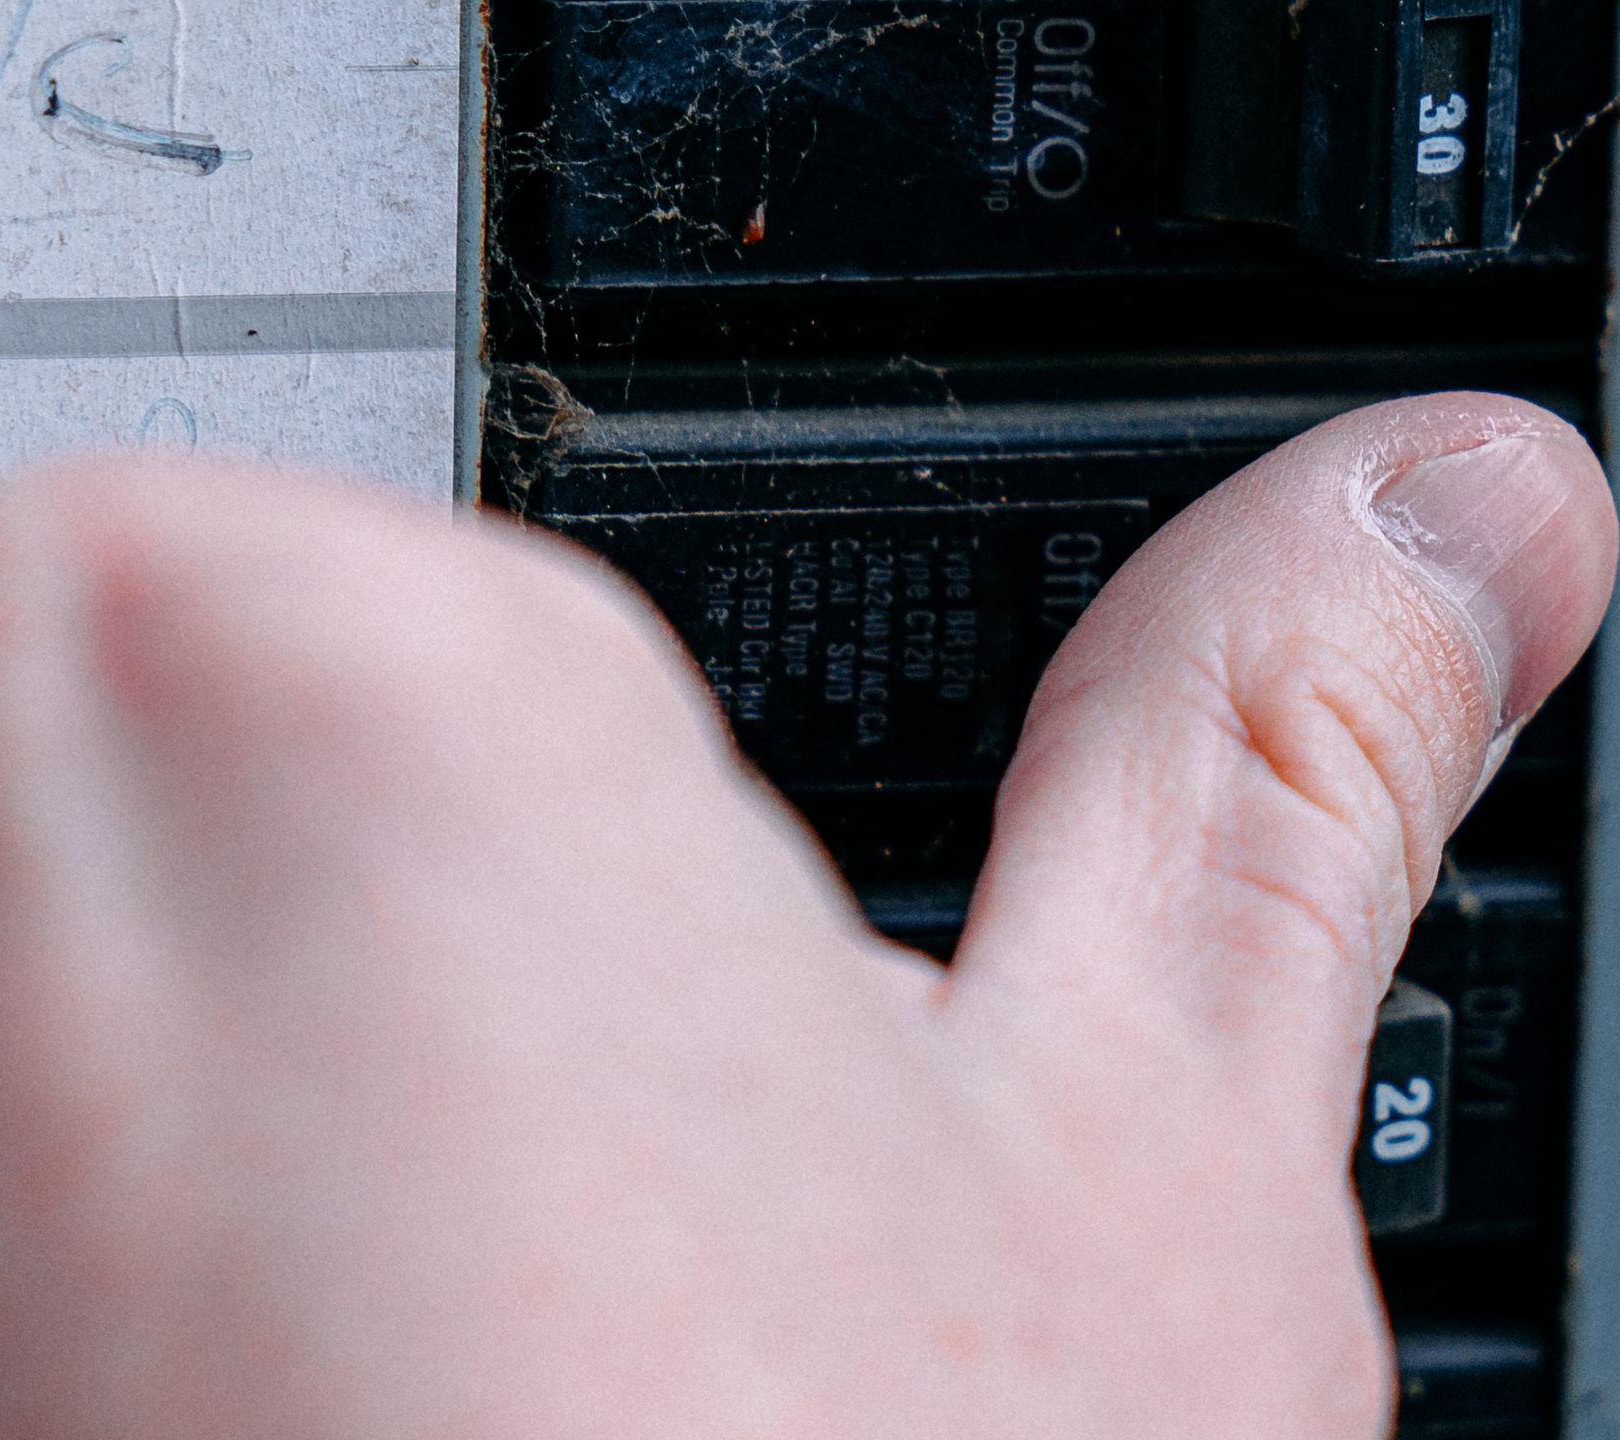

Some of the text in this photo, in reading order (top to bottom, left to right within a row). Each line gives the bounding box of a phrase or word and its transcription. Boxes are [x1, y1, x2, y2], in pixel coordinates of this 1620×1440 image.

[981, 18, 1025, 212] Common Trip
[1415, 93, 1467, 178] 30
[901, 536, 939, 681] Type C120
[942, 537, 980, 600] Type
[779, 620, 818, 678] Type
[824, 641, 856, 704] SWD
[1373, 1076, 1432, 1162] 20
